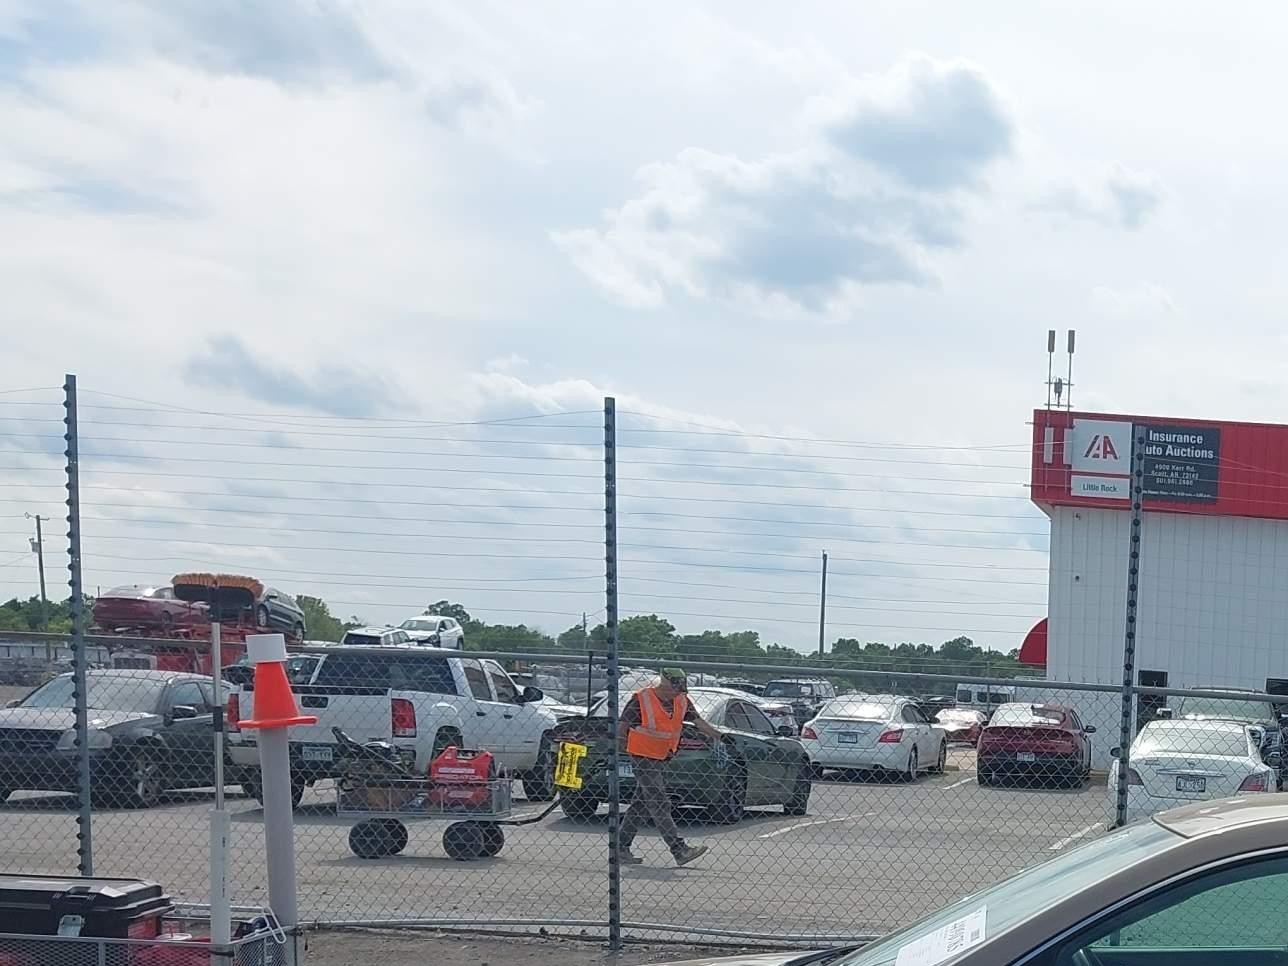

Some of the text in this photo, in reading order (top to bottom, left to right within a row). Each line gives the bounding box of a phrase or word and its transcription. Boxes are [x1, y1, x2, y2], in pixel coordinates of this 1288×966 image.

[1150, 430, 1203, 443] Insurance
[1145, 445, 1214, 459] uto Auctions
[1082, 483, 1117, 493] Little Rock
